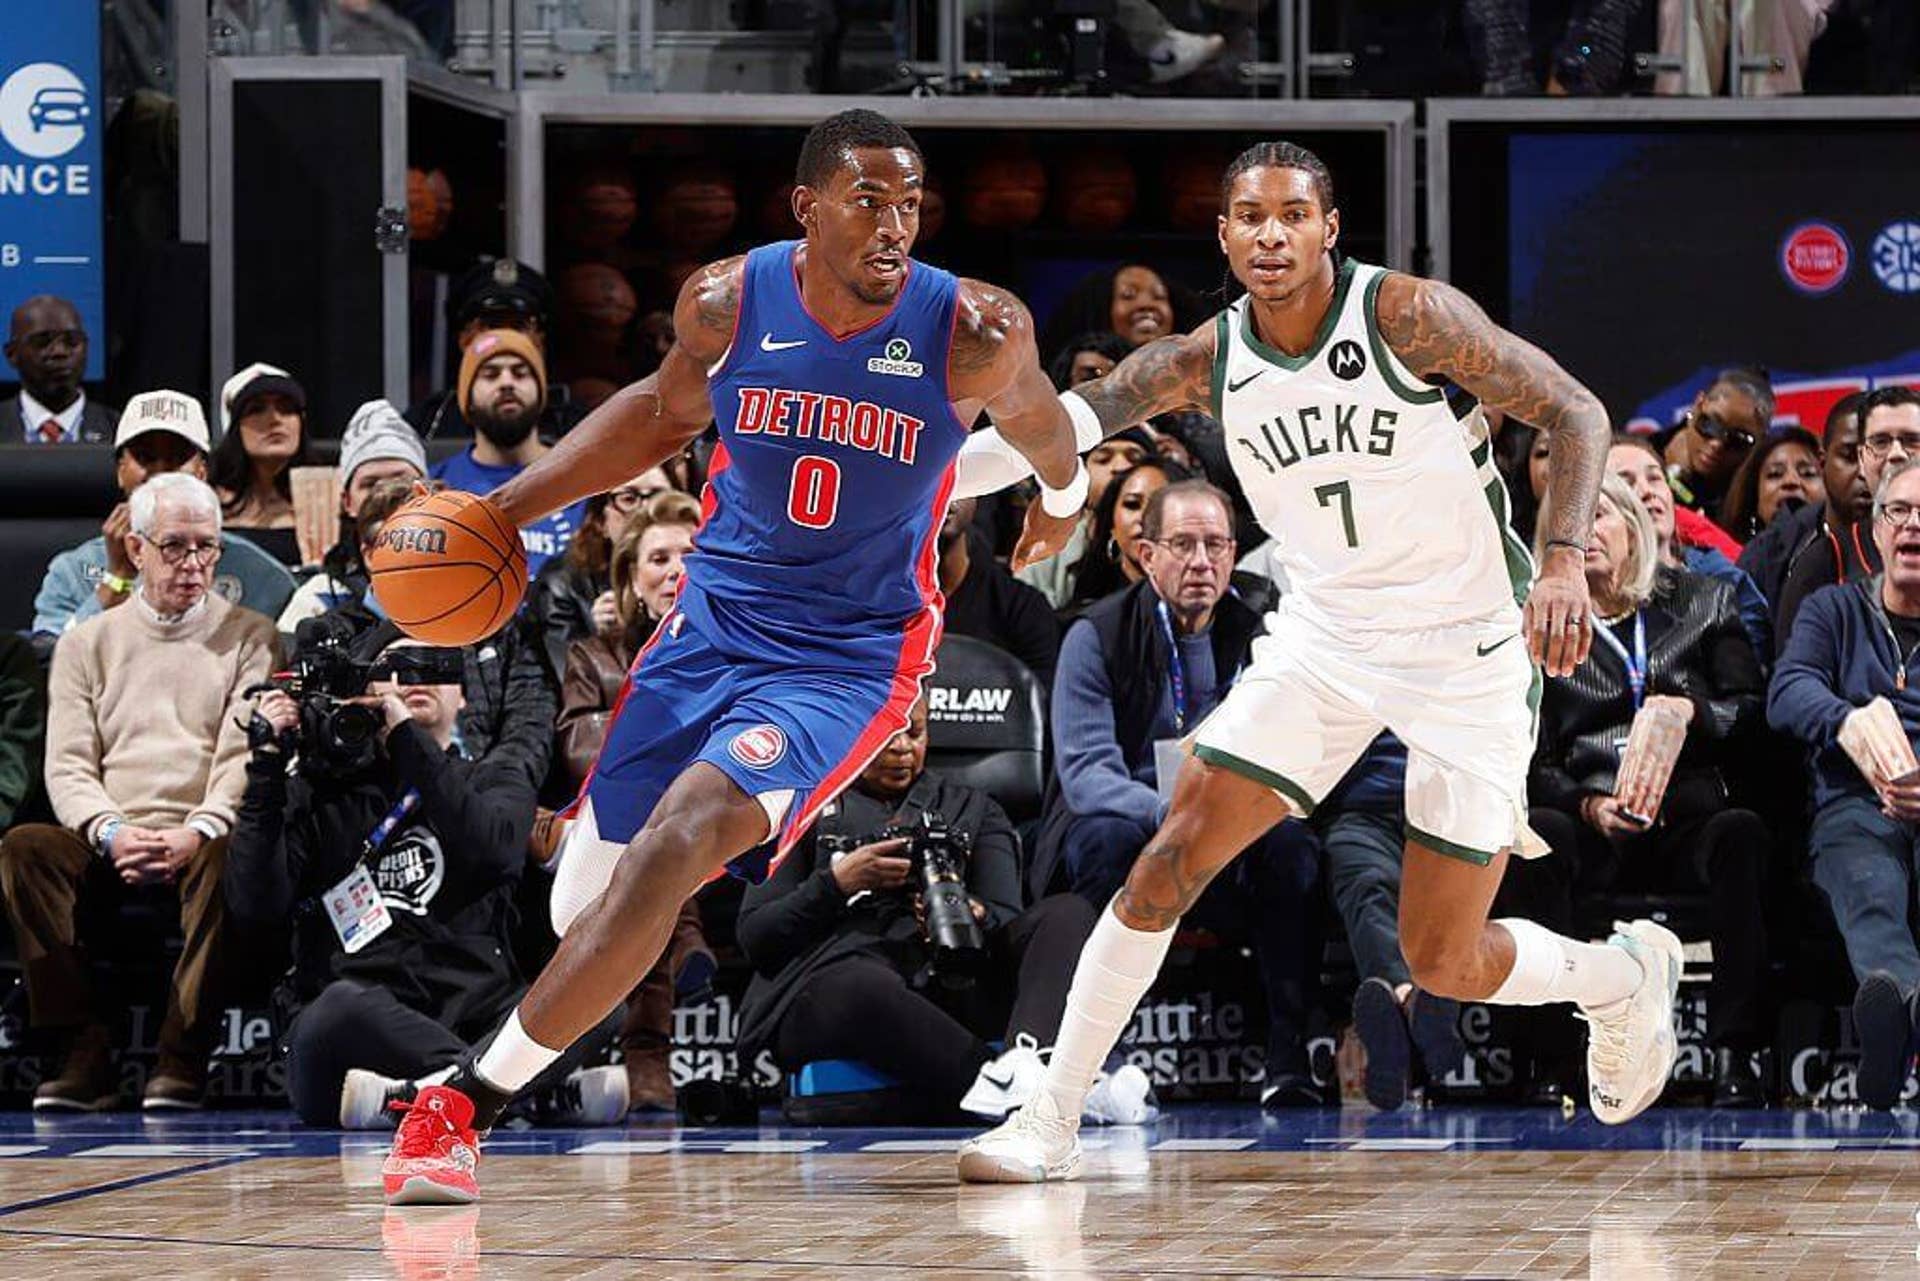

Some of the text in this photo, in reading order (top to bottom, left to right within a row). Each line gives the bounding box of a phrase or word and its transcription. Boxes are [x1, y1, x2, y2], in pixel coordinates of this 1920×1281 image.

[0, 164, 91, 195] NCE
[735, 387, 925, 466] DETROIT
[787, 454, 841, 530] 0
[1313, 479, 1360, 548] 7
